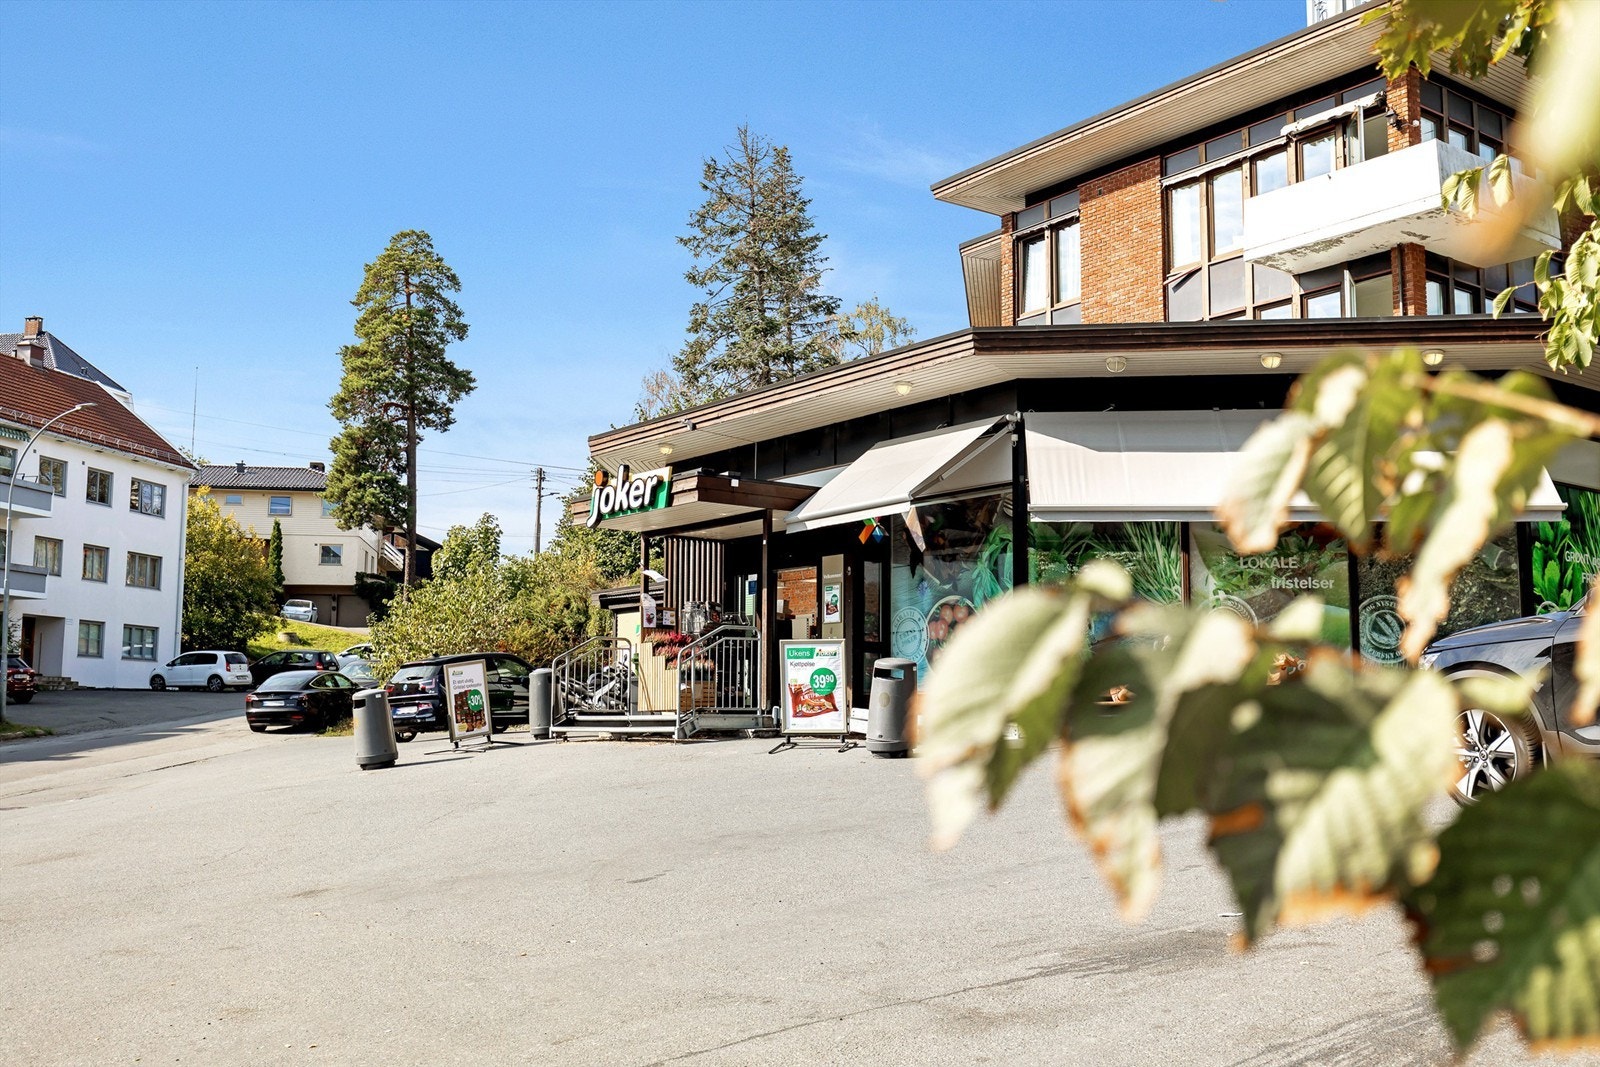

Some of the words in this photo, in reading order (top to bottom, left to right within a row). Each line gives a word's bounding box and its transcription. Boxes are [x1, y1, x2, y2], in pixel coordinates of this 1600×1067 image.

[586, 464, 658, 528] joker
[1240, 557, 1299, 569] LOKALE
[1270, 576, 1335, 589] fristelser
[788, 649, 811, 657] Ukens
